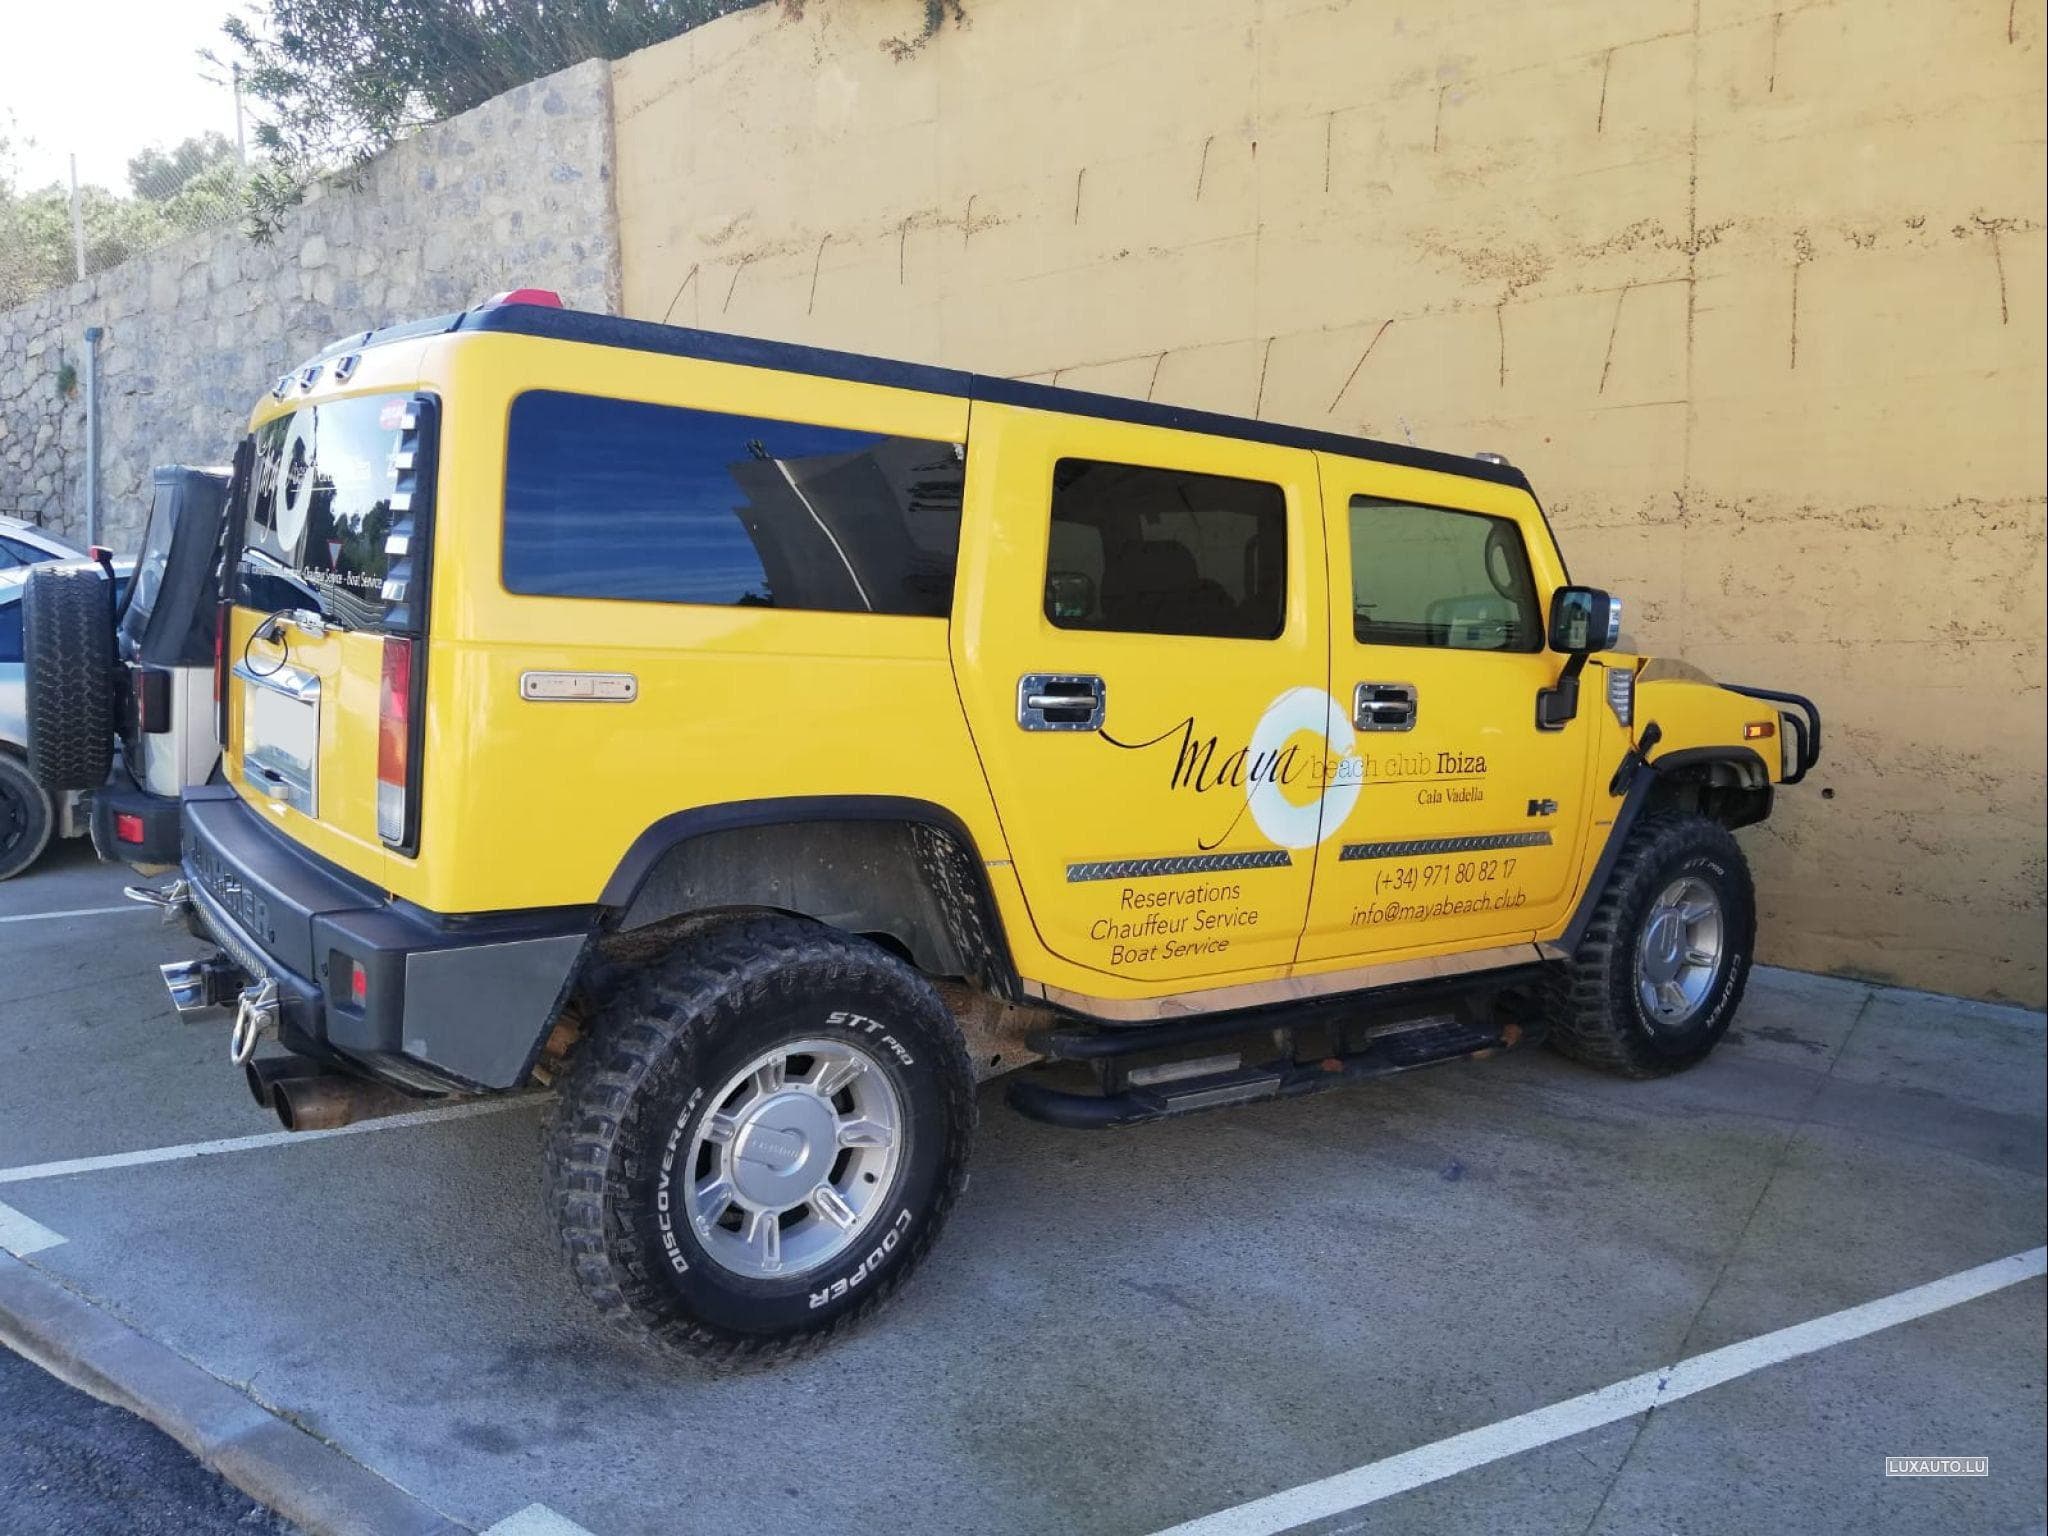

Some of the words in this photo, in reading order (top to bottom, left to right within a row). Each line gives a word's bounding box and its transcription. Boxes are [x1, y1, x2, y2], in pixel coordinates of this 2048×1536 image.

[1099, 716, 1308, 850] Maya
[1311, 752, 1377, 779] beach
[1384, 751, 1431, 776] club
[1436, 750, 1488, 774] Ibiza
[1417, 788, 1443, 805] Cala
[1446, 785, 1484, 803] Vadella
[1375, 867, 1419, 895] (+34)
[1423, 863, 1450, 887] 971
[1455, 861, 1475, 884] 80
[1478, 859, 1498, 882] 82
[1503, 858, 1518, 879] 17
[1120, 882, 1241, 911] Reservations
[1351, 888, 1527, 926] info@mayabeach.club
[1090, 912, 1189, 941] Chauffeur
[1193, 906, 1259, 932] Service
[1110, 944, 1160, 966] Boat
[1162, 937, 1230, 960] Service
[825, 1010, 885, 1035] STT
[881, 1032, 915, 1067] PRO
[656, 1086, 704, 1276] DISCOVERER
[809, 1208, 913, 1310] COOPER
